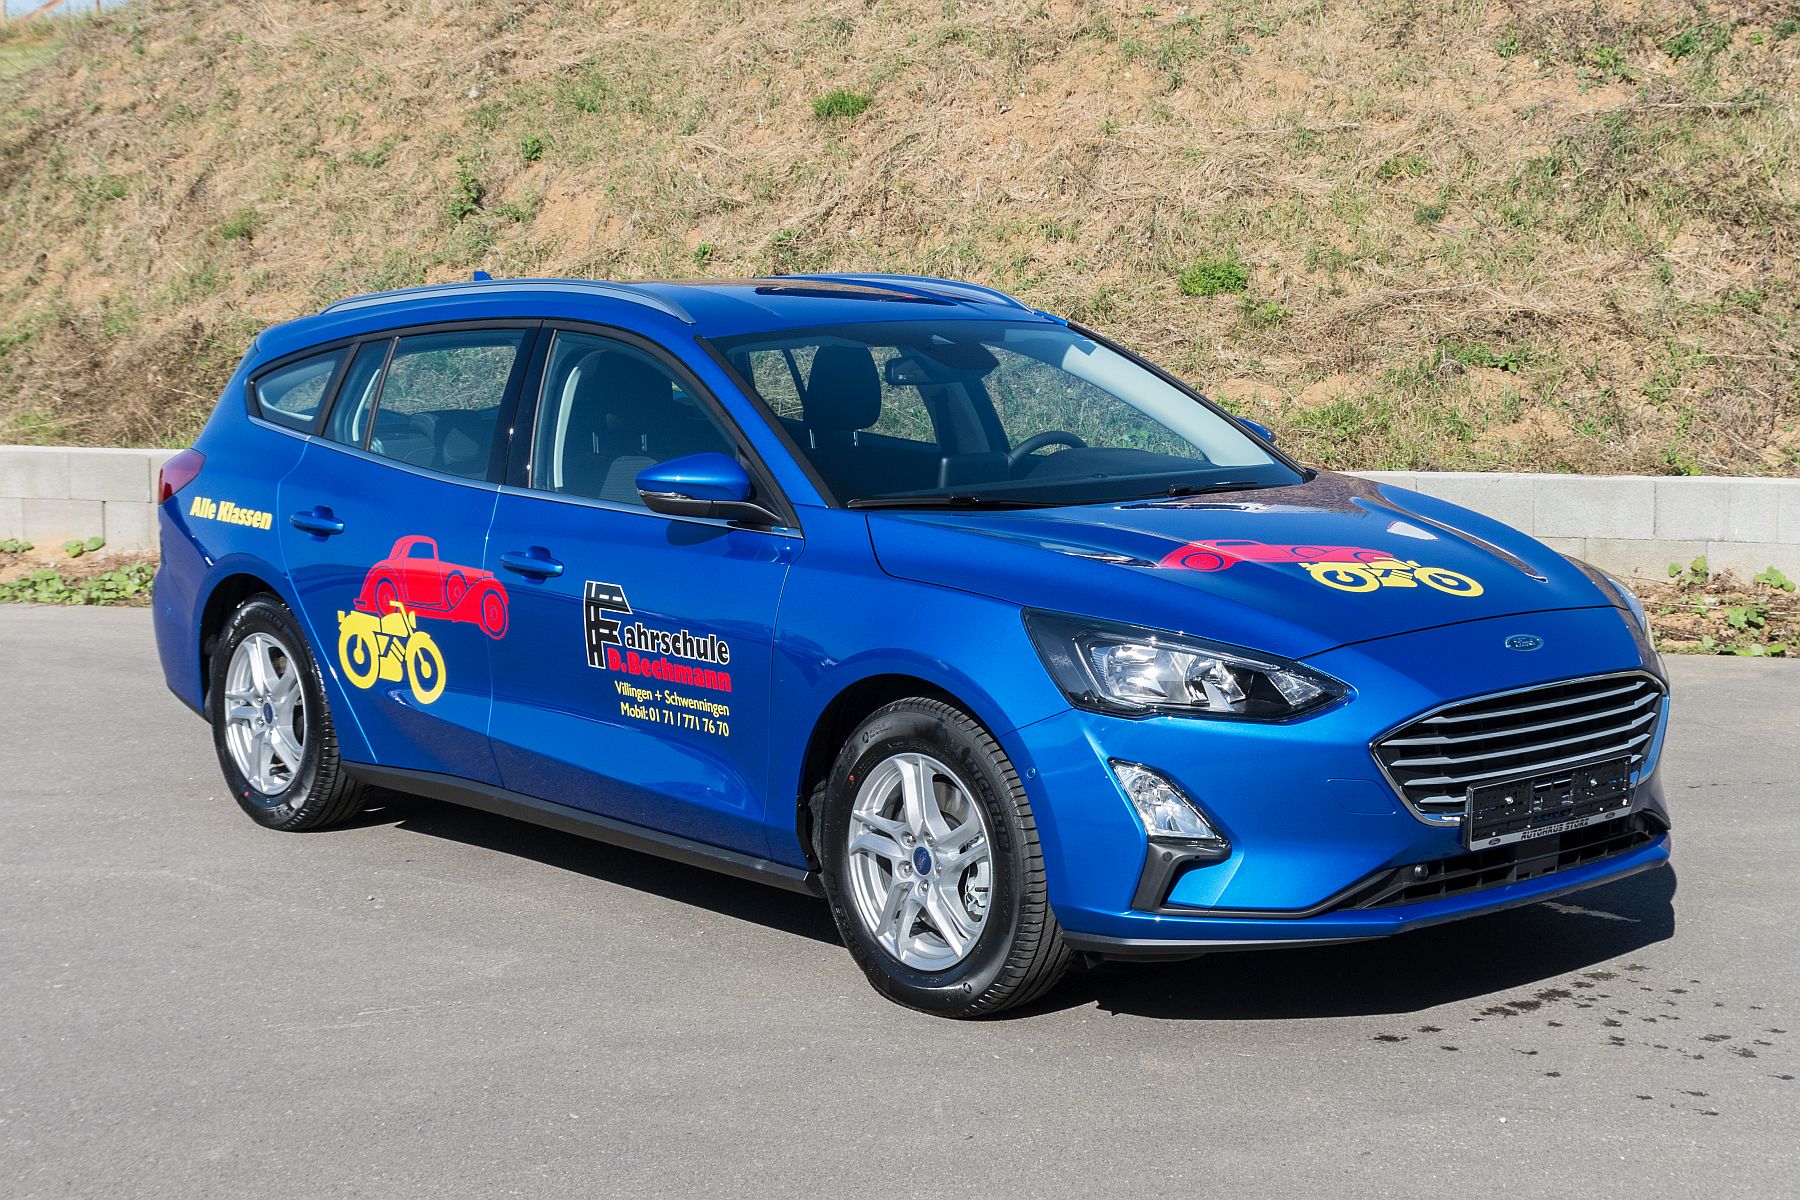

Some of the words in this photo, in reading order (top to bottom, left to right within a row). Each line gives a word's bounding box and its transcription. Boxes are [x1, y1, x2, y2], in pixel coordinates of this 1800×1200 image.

[189, 496, 217, 519] Alle
[216, 501, 273, 530] Klassen
[614, 680, 653, 702] Villingen
[655, 690, 662, 701] +
[664, 689, 730, 717] Schwenningen
[702, 717, 716, 732] 76
[716, 720, 730, 737] 70
[1520, 823, 1563, 841] AUTOHAUS
